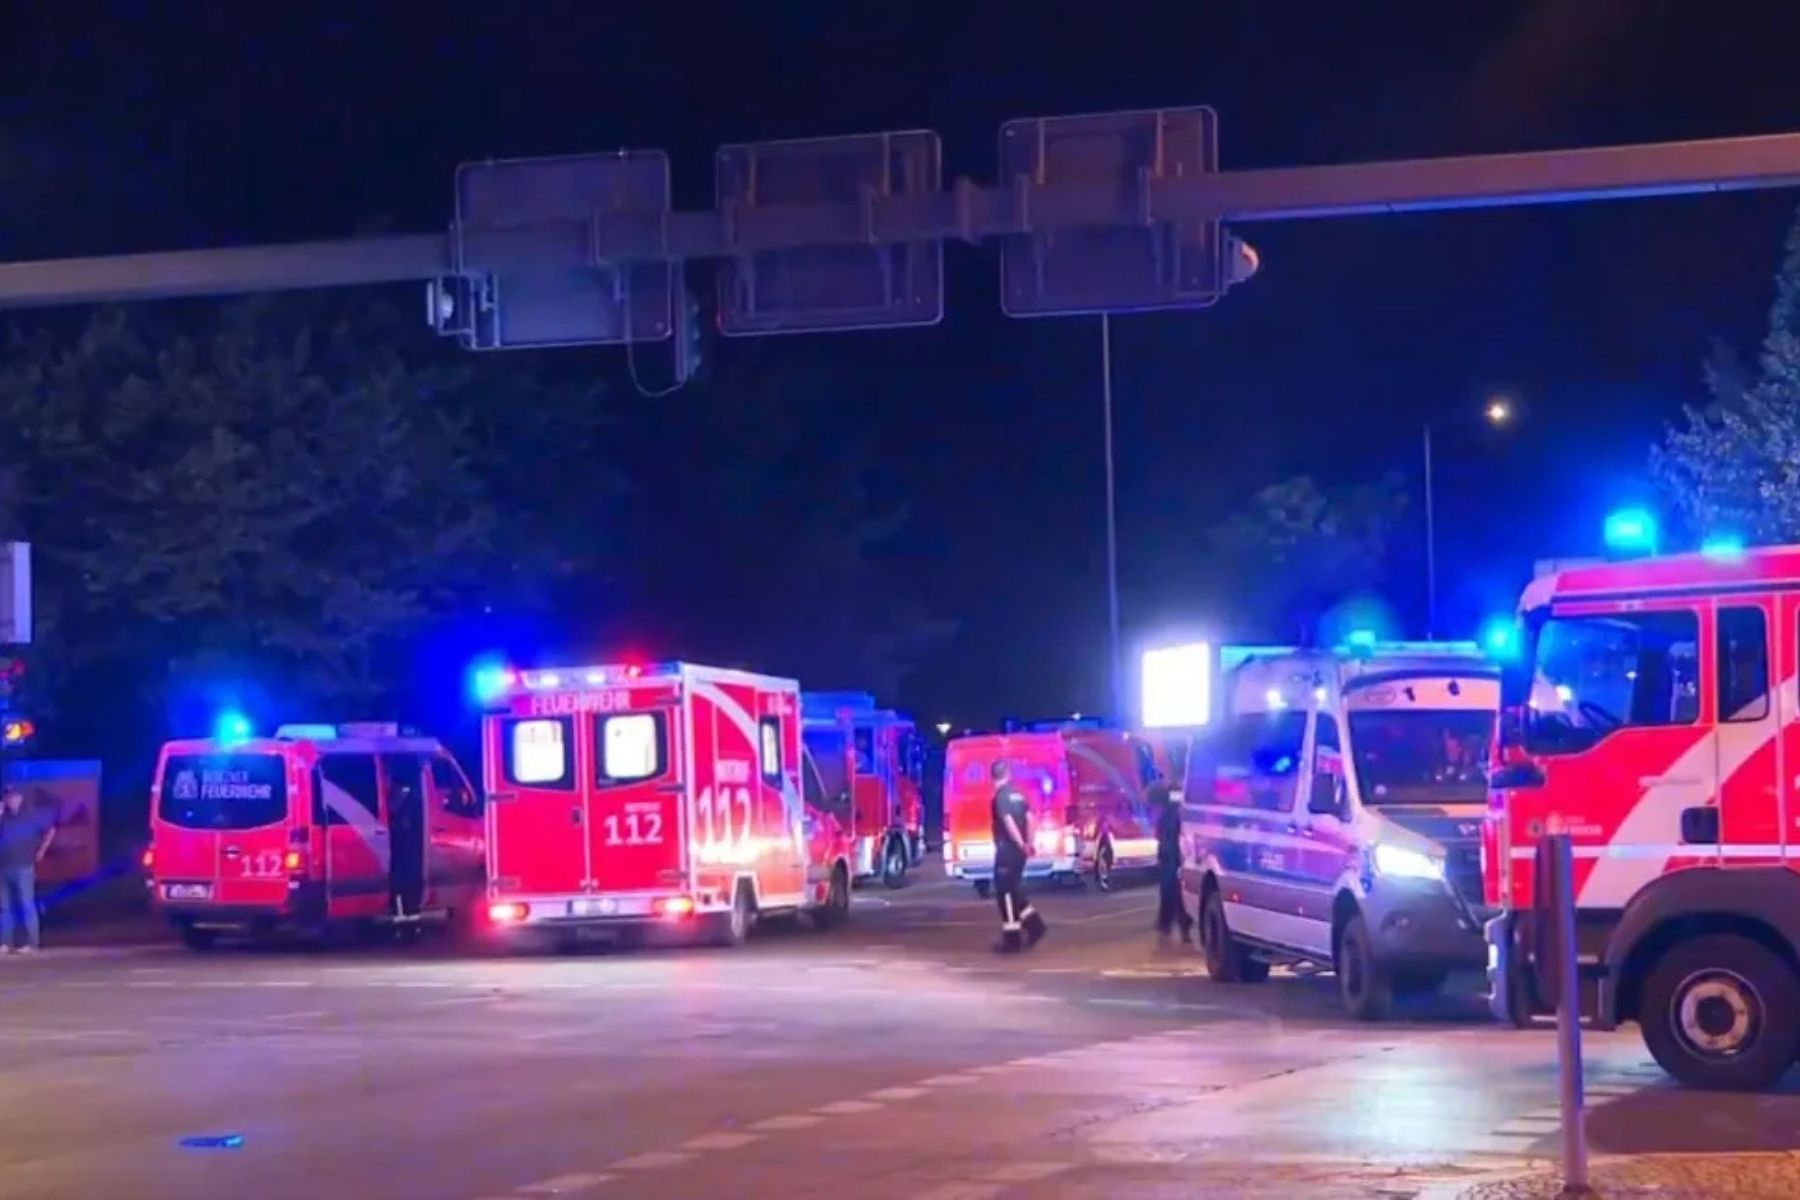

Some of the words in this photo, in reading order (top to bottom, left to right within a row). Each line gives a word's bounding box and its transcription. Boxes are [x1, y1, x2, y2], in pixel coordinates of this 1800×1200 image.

[532, 689, 630, 715] FEUERWEHR
[604, 814, 663, 846] 112
[698, 786, 752, 850] 112
[241, 855, 282, 877] 112
